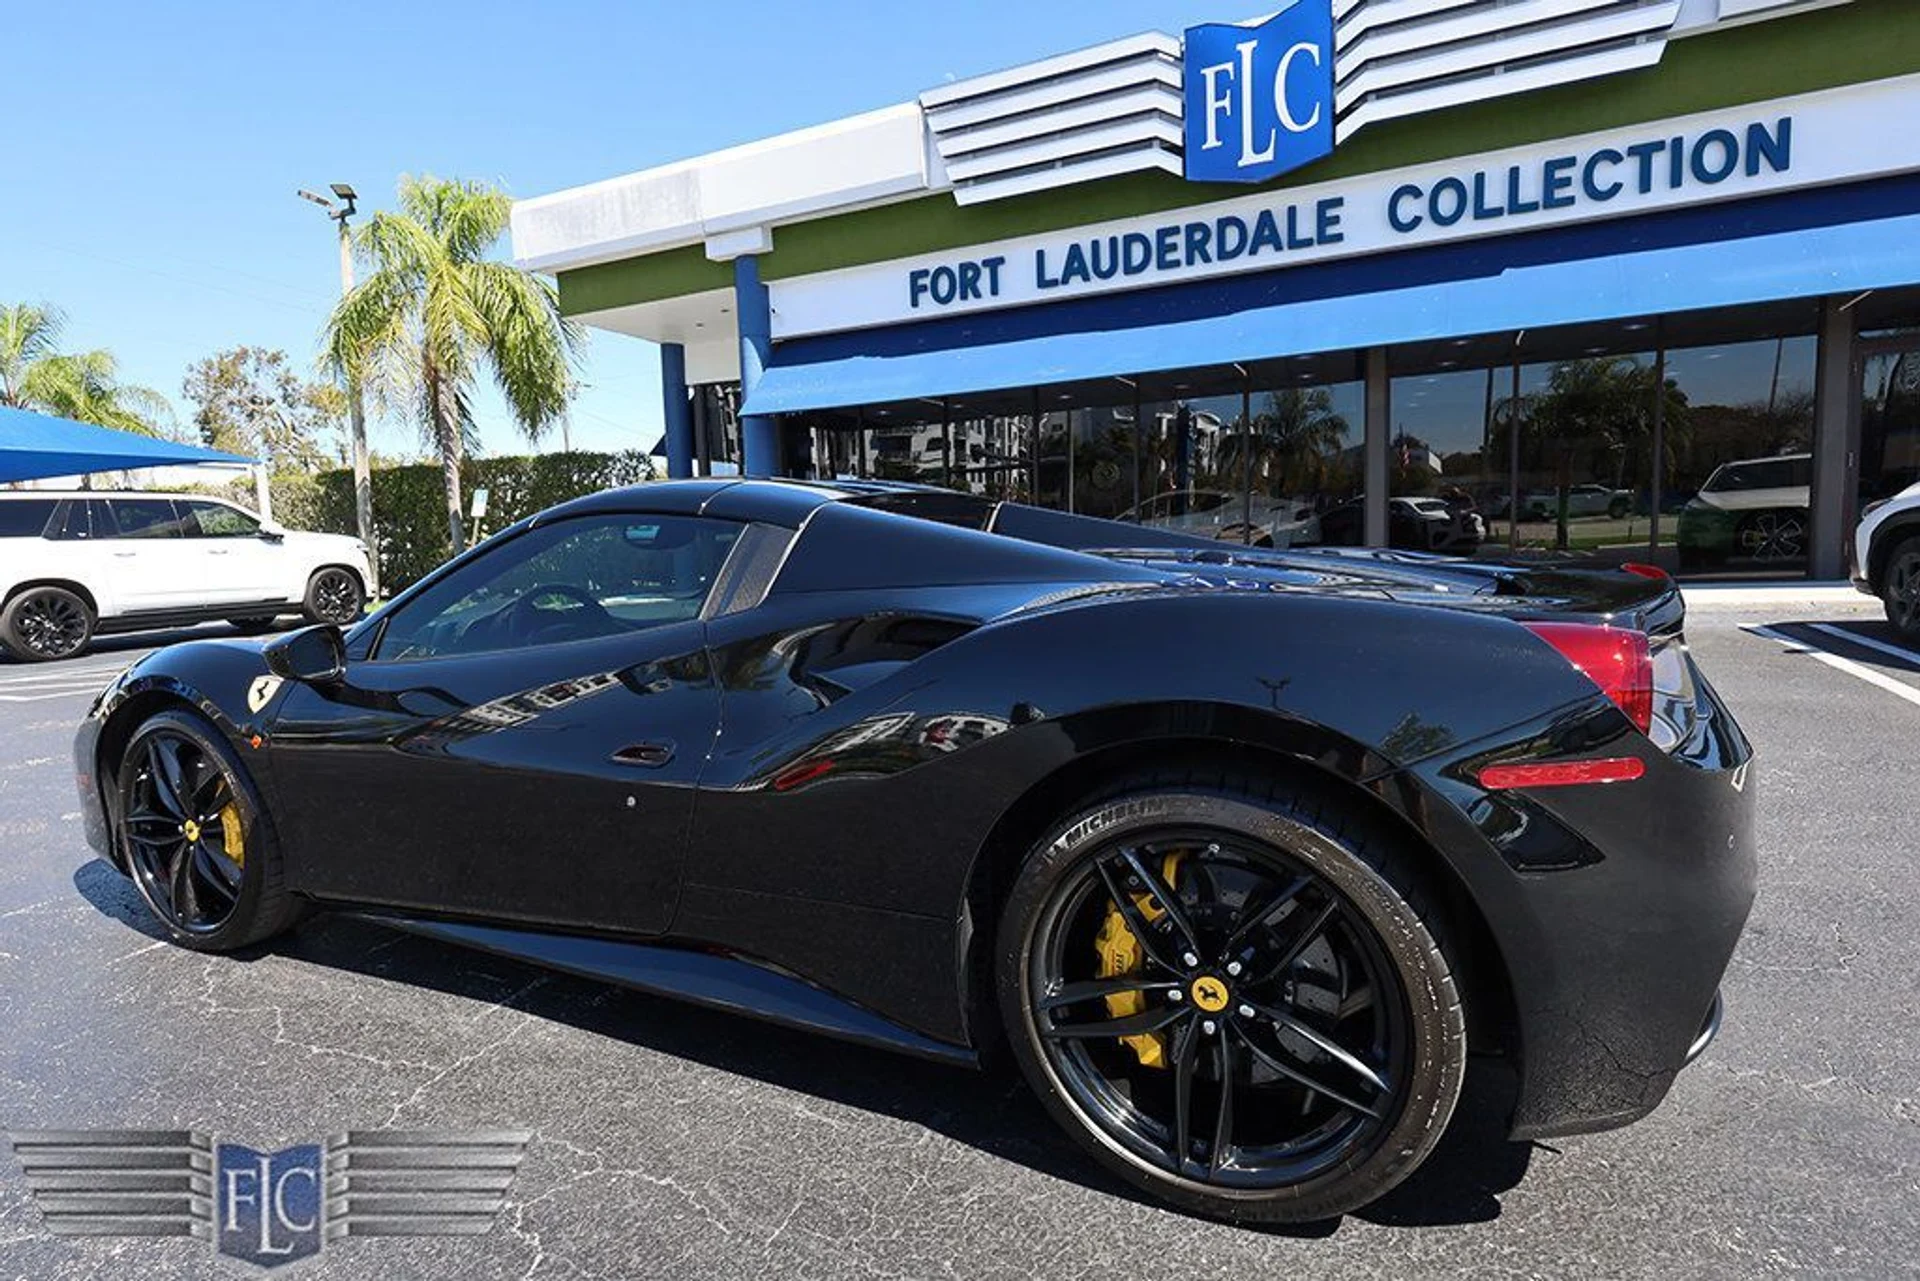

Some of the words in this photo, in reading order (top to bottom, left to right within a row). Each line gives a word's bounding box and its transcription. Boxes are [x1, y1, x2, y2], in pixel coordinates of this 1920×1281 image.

[1200, 40, 1320, 167] FLC
[909, 256, 1006, 308] FORT
[1036, 196, 1344, 289] LAUDERDALE
[1387, 117, 1792, 233] COLLECTION
[1064, 797, 1168, 848] MICHELIN
